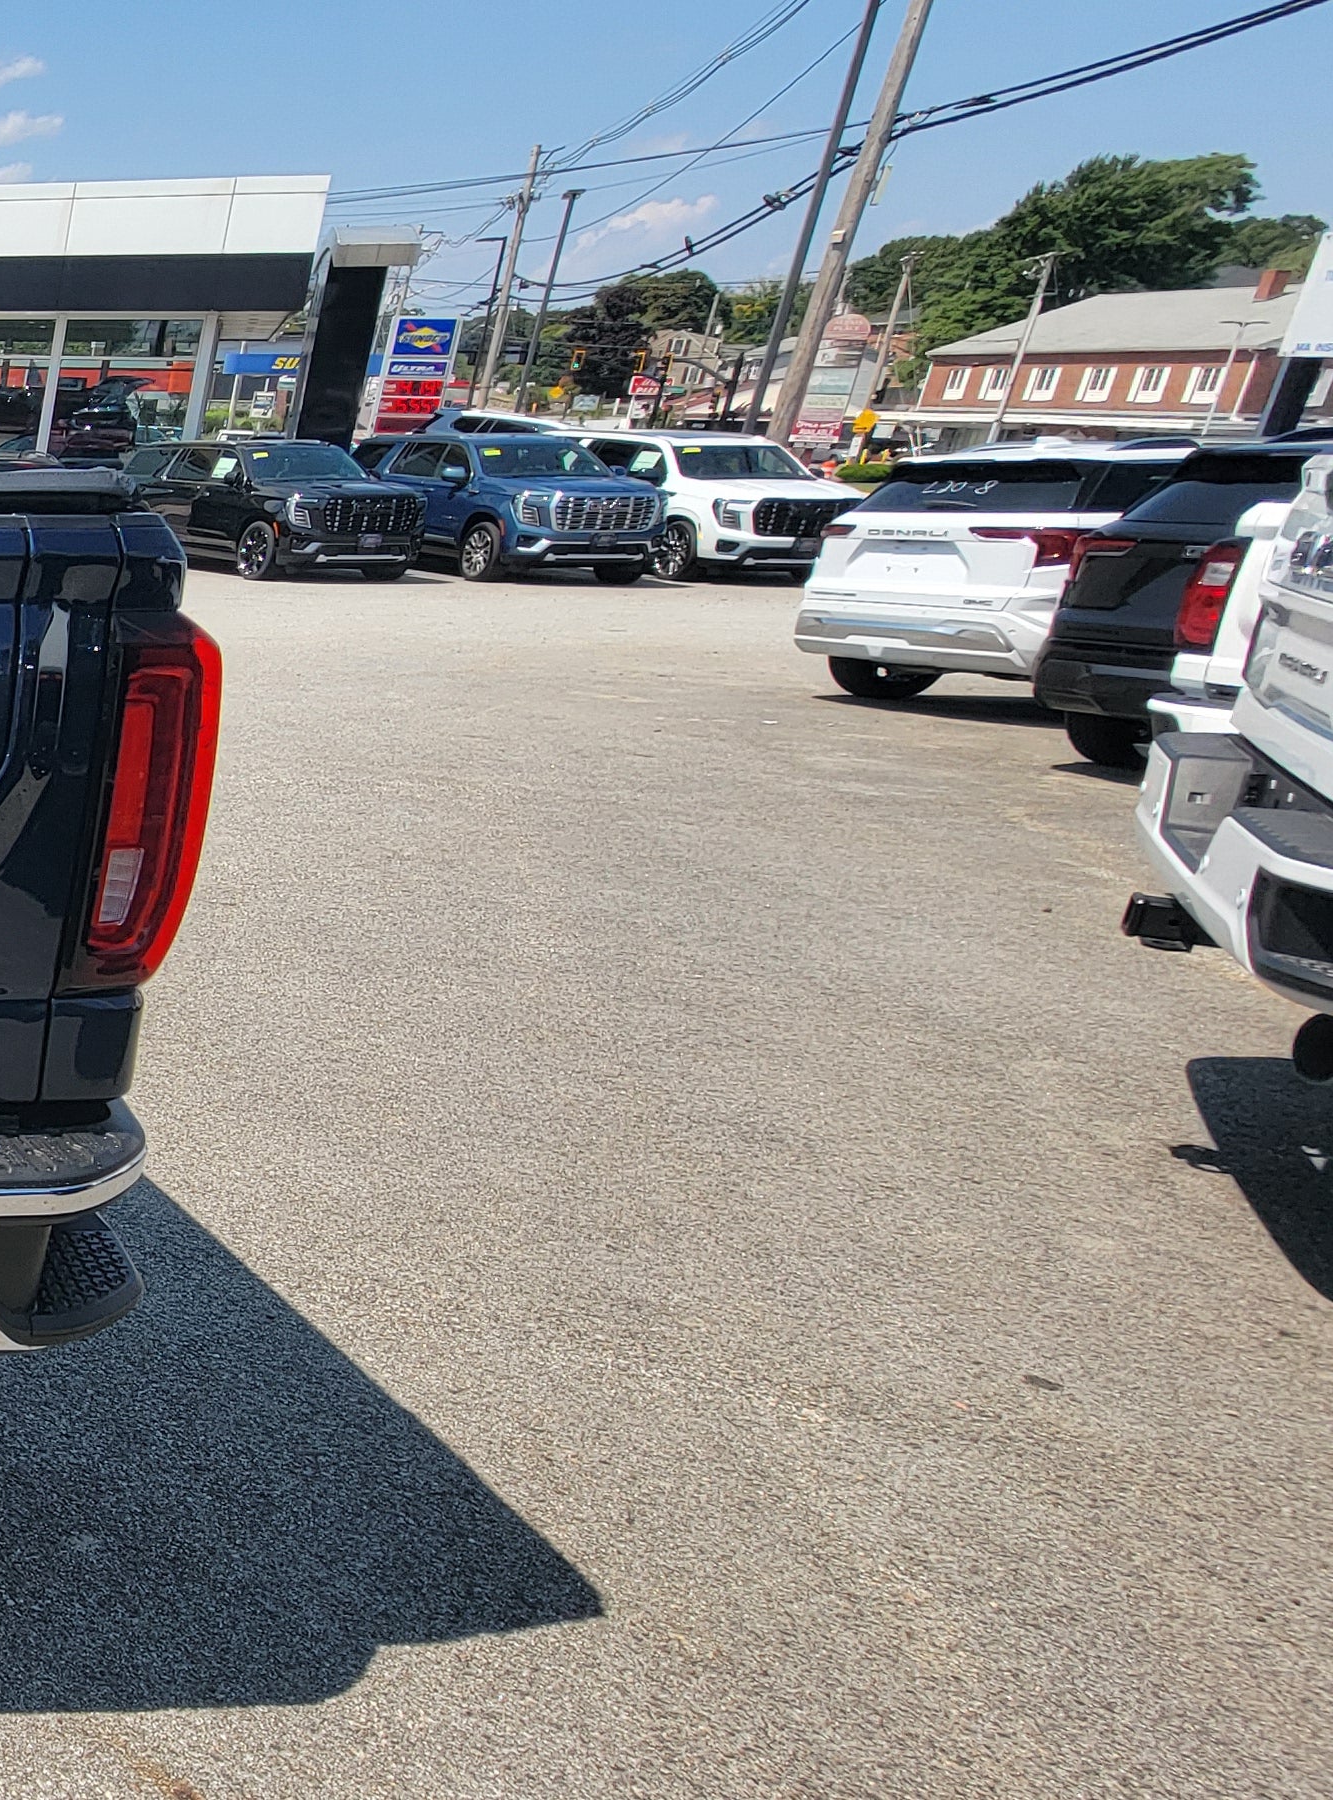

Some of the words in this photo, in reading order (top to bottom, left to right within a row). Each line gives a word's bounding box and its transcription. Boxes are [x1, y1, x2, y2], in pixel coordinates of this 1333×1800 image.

[398, 332, 450, 344] SUNOCO
[391, 364, 436, 374] ULTRA
[868, 529, 949, 537] DENALI
[963, 598, 993, 607] GMC
